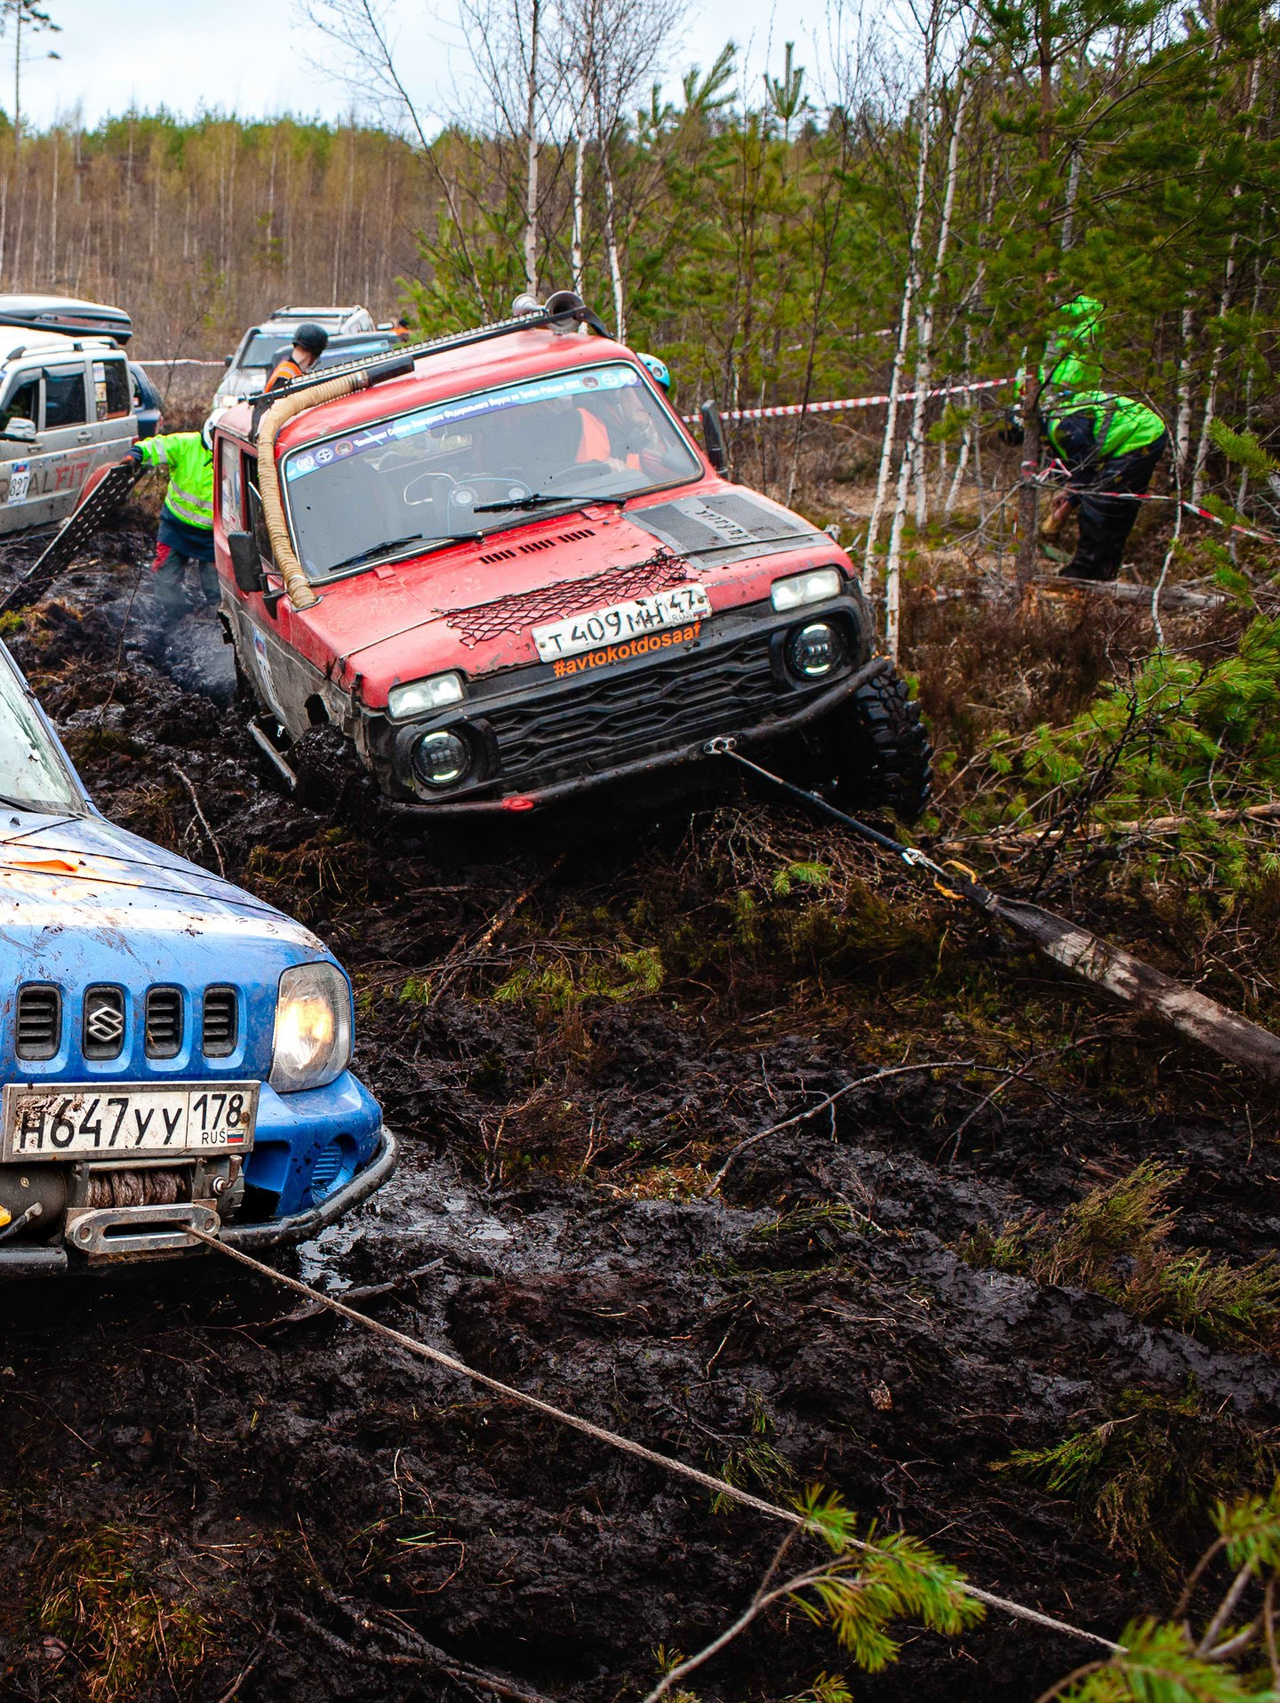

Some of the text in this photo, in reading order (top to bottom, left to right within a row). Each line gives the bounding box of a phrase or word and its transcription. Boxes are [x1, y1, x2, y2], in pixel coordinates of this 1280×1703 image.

[9, 477, 28, 498] 827
[552, 621, 702, 678] #avtokotdosaaf
[192, 1093, 244, 1131] 178
[201, 1130, 227, 1145] RUS
